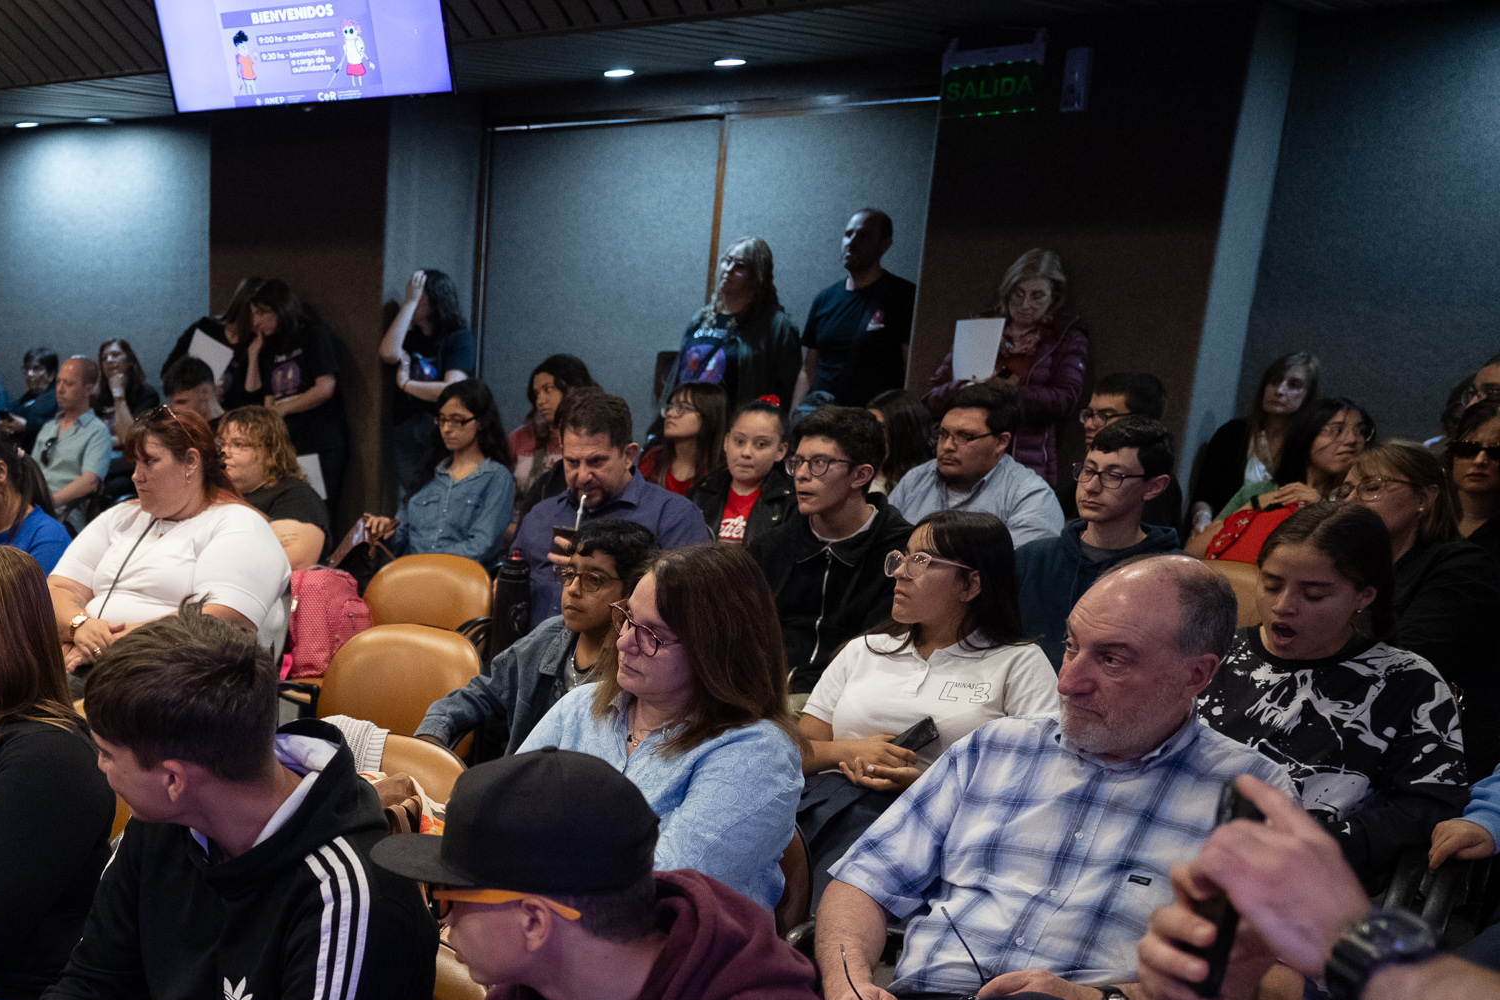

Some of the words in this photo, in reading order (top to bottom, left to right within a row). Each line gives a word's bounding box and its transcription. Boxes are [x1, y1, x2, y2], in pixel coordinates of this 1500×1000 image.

[251, 4, 334, 24] BIENVENIDOS
[258, 35, 274, 44] 9:00
[287, 31, 335, 41] acreditaciones
[261, 52, 277, 61] 9:30
[289, 48, 326, 58] bienvenida
[292, 63, 332, 73] autoridades
[296, 58, 315, 66] cargo
[946, 75, 1033, 101] SALIDA
[317, 91, 337, 102] CeR
[954, 682, 976, 690] MINAS
